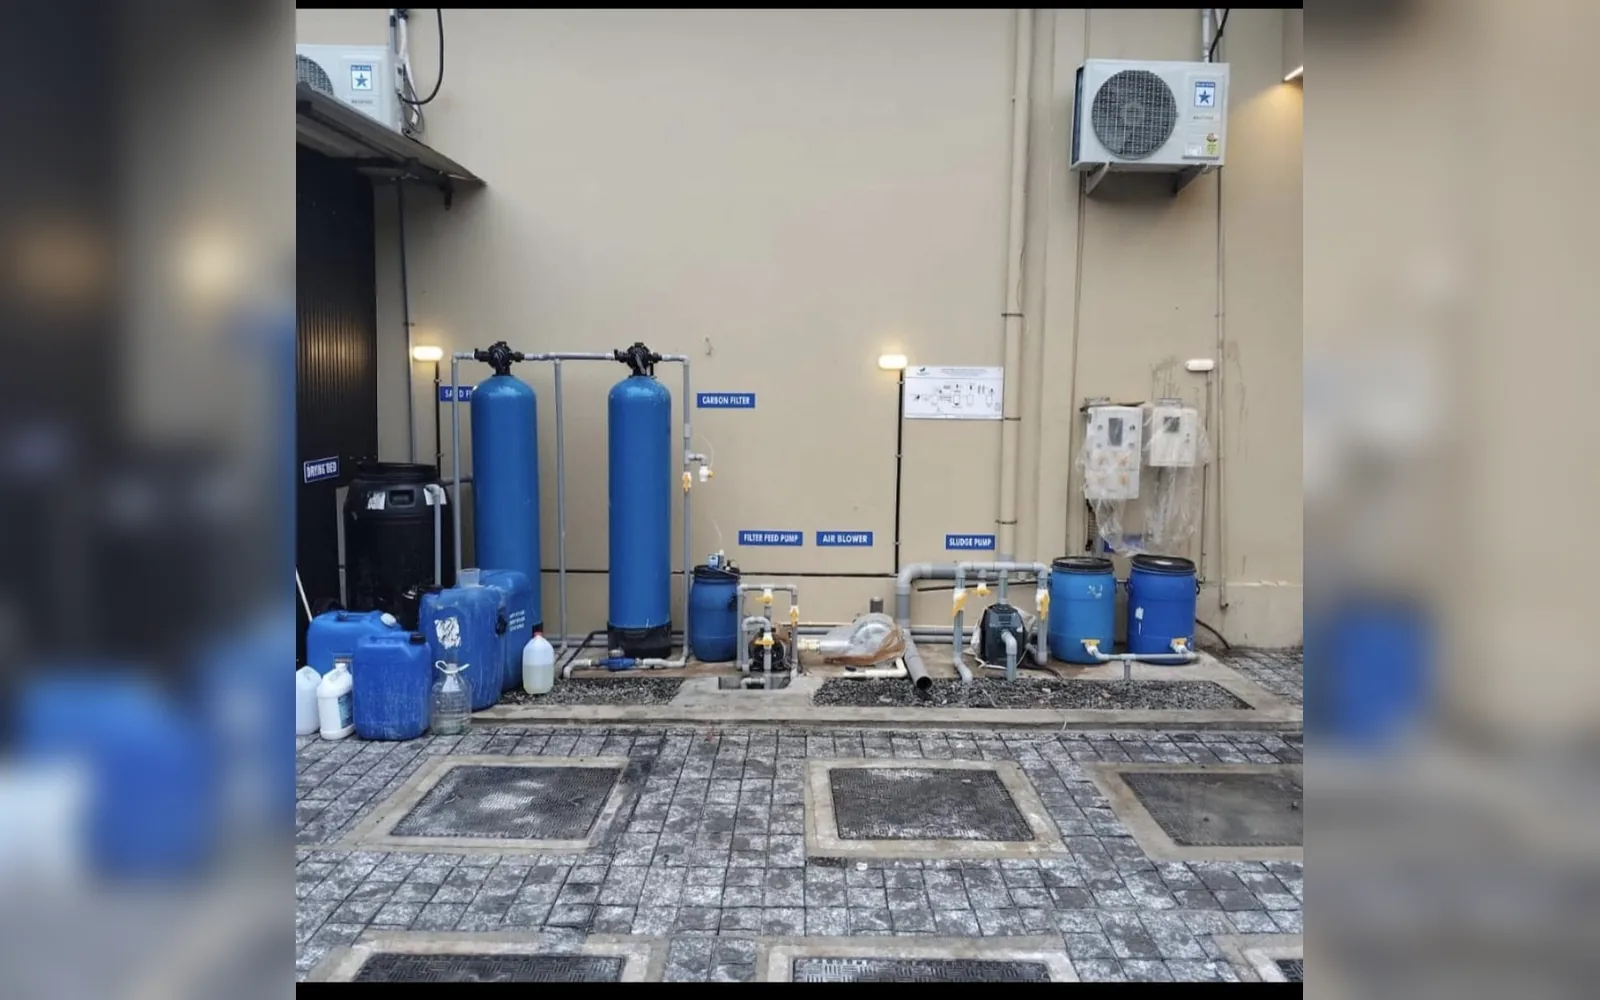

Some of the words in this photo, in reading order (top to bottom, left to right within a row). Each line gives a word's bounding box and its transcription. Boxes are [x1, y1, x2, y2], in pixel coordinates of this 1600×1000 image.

[444, 389, 464, 398] SAD
[702, 396, 728, 404] CARBON
[730, 396, 750, 404] FILTER
[326, 461, 337, 474] BED
[744, 533, 763, 542] FILTER
[764, 533, 779, 543] FEED
[780, 533, 798, 543] PUMP
[822, 534, 836, 543] AIR
[837, 534, 868, 543] BLOWER
[949, 537, 973, 547] SLUDGE
[974, 537, 992, 547] PUMP
